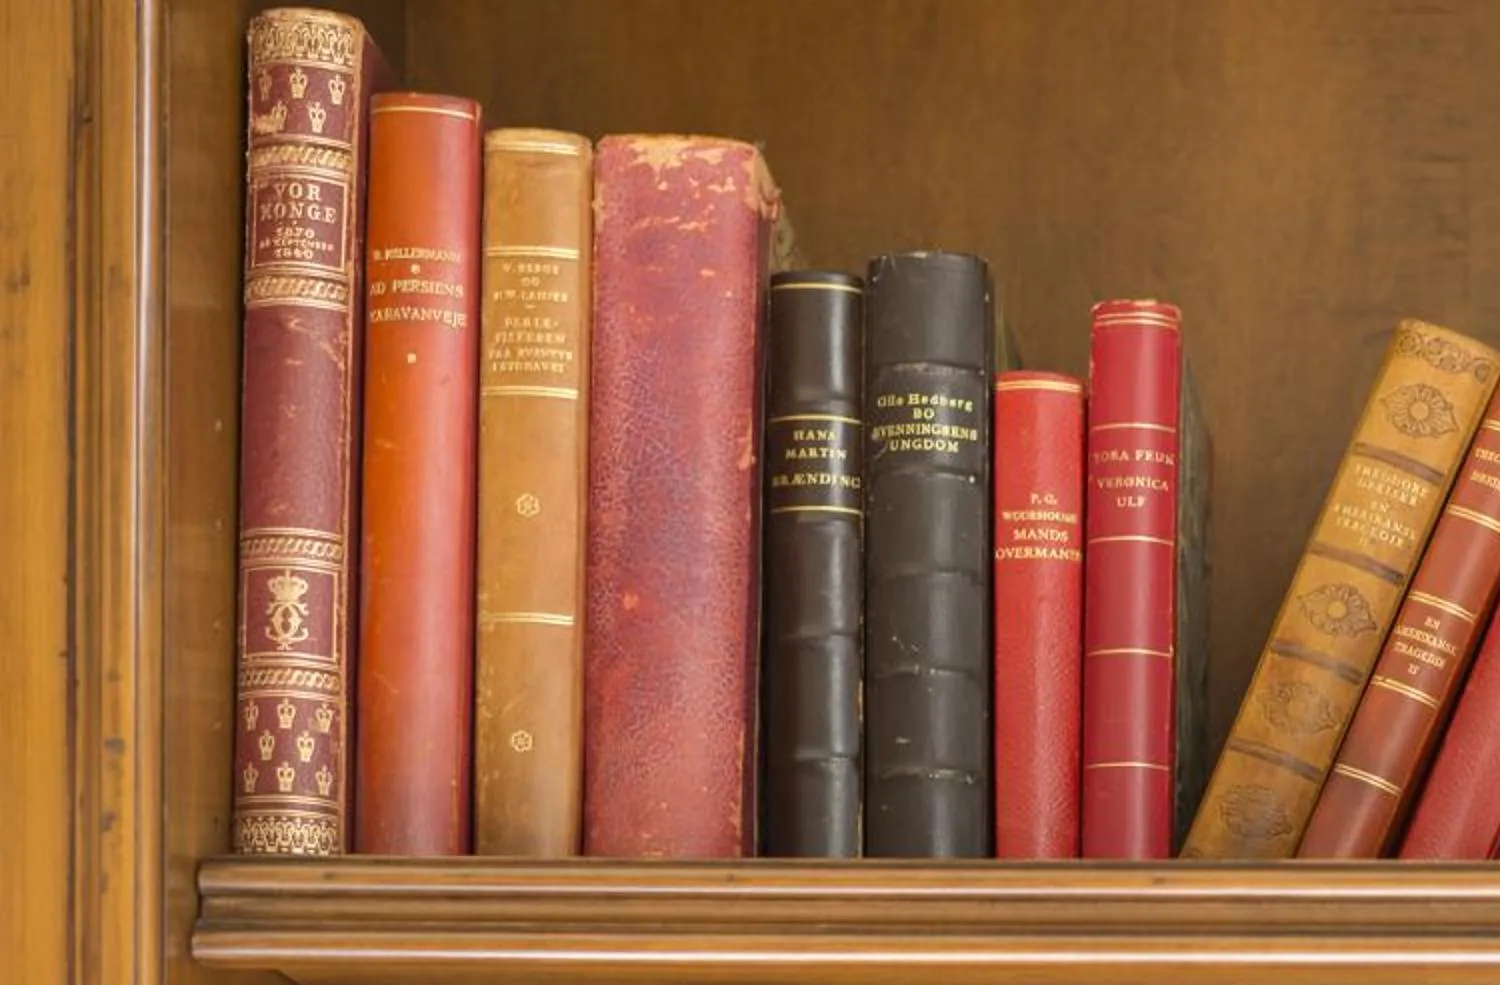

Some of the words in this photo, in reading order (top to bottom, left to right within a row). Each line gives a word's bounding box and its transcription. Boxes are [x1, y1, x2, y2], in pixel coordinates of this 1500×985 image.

[273, 182, 321, 201] VOR
[260, 201, 337, 224] KONGE
[393, 280, 464, 298] PERSIENS
[908, 394, 973, 412] Hedberg
[913, 408, 935, 420] BO
[793, 430, 837, 442] HANS
[889, 439, 959, 453] UNGDOM
[786, 448, 846, 460] MARTIN
[1097, 477, 1169, 492] VERONICA
[1031, 494, 1041, 505] P.
[1044, 495, 1057, 505] G.
[1013, 529, 1069, 542] MANDS
